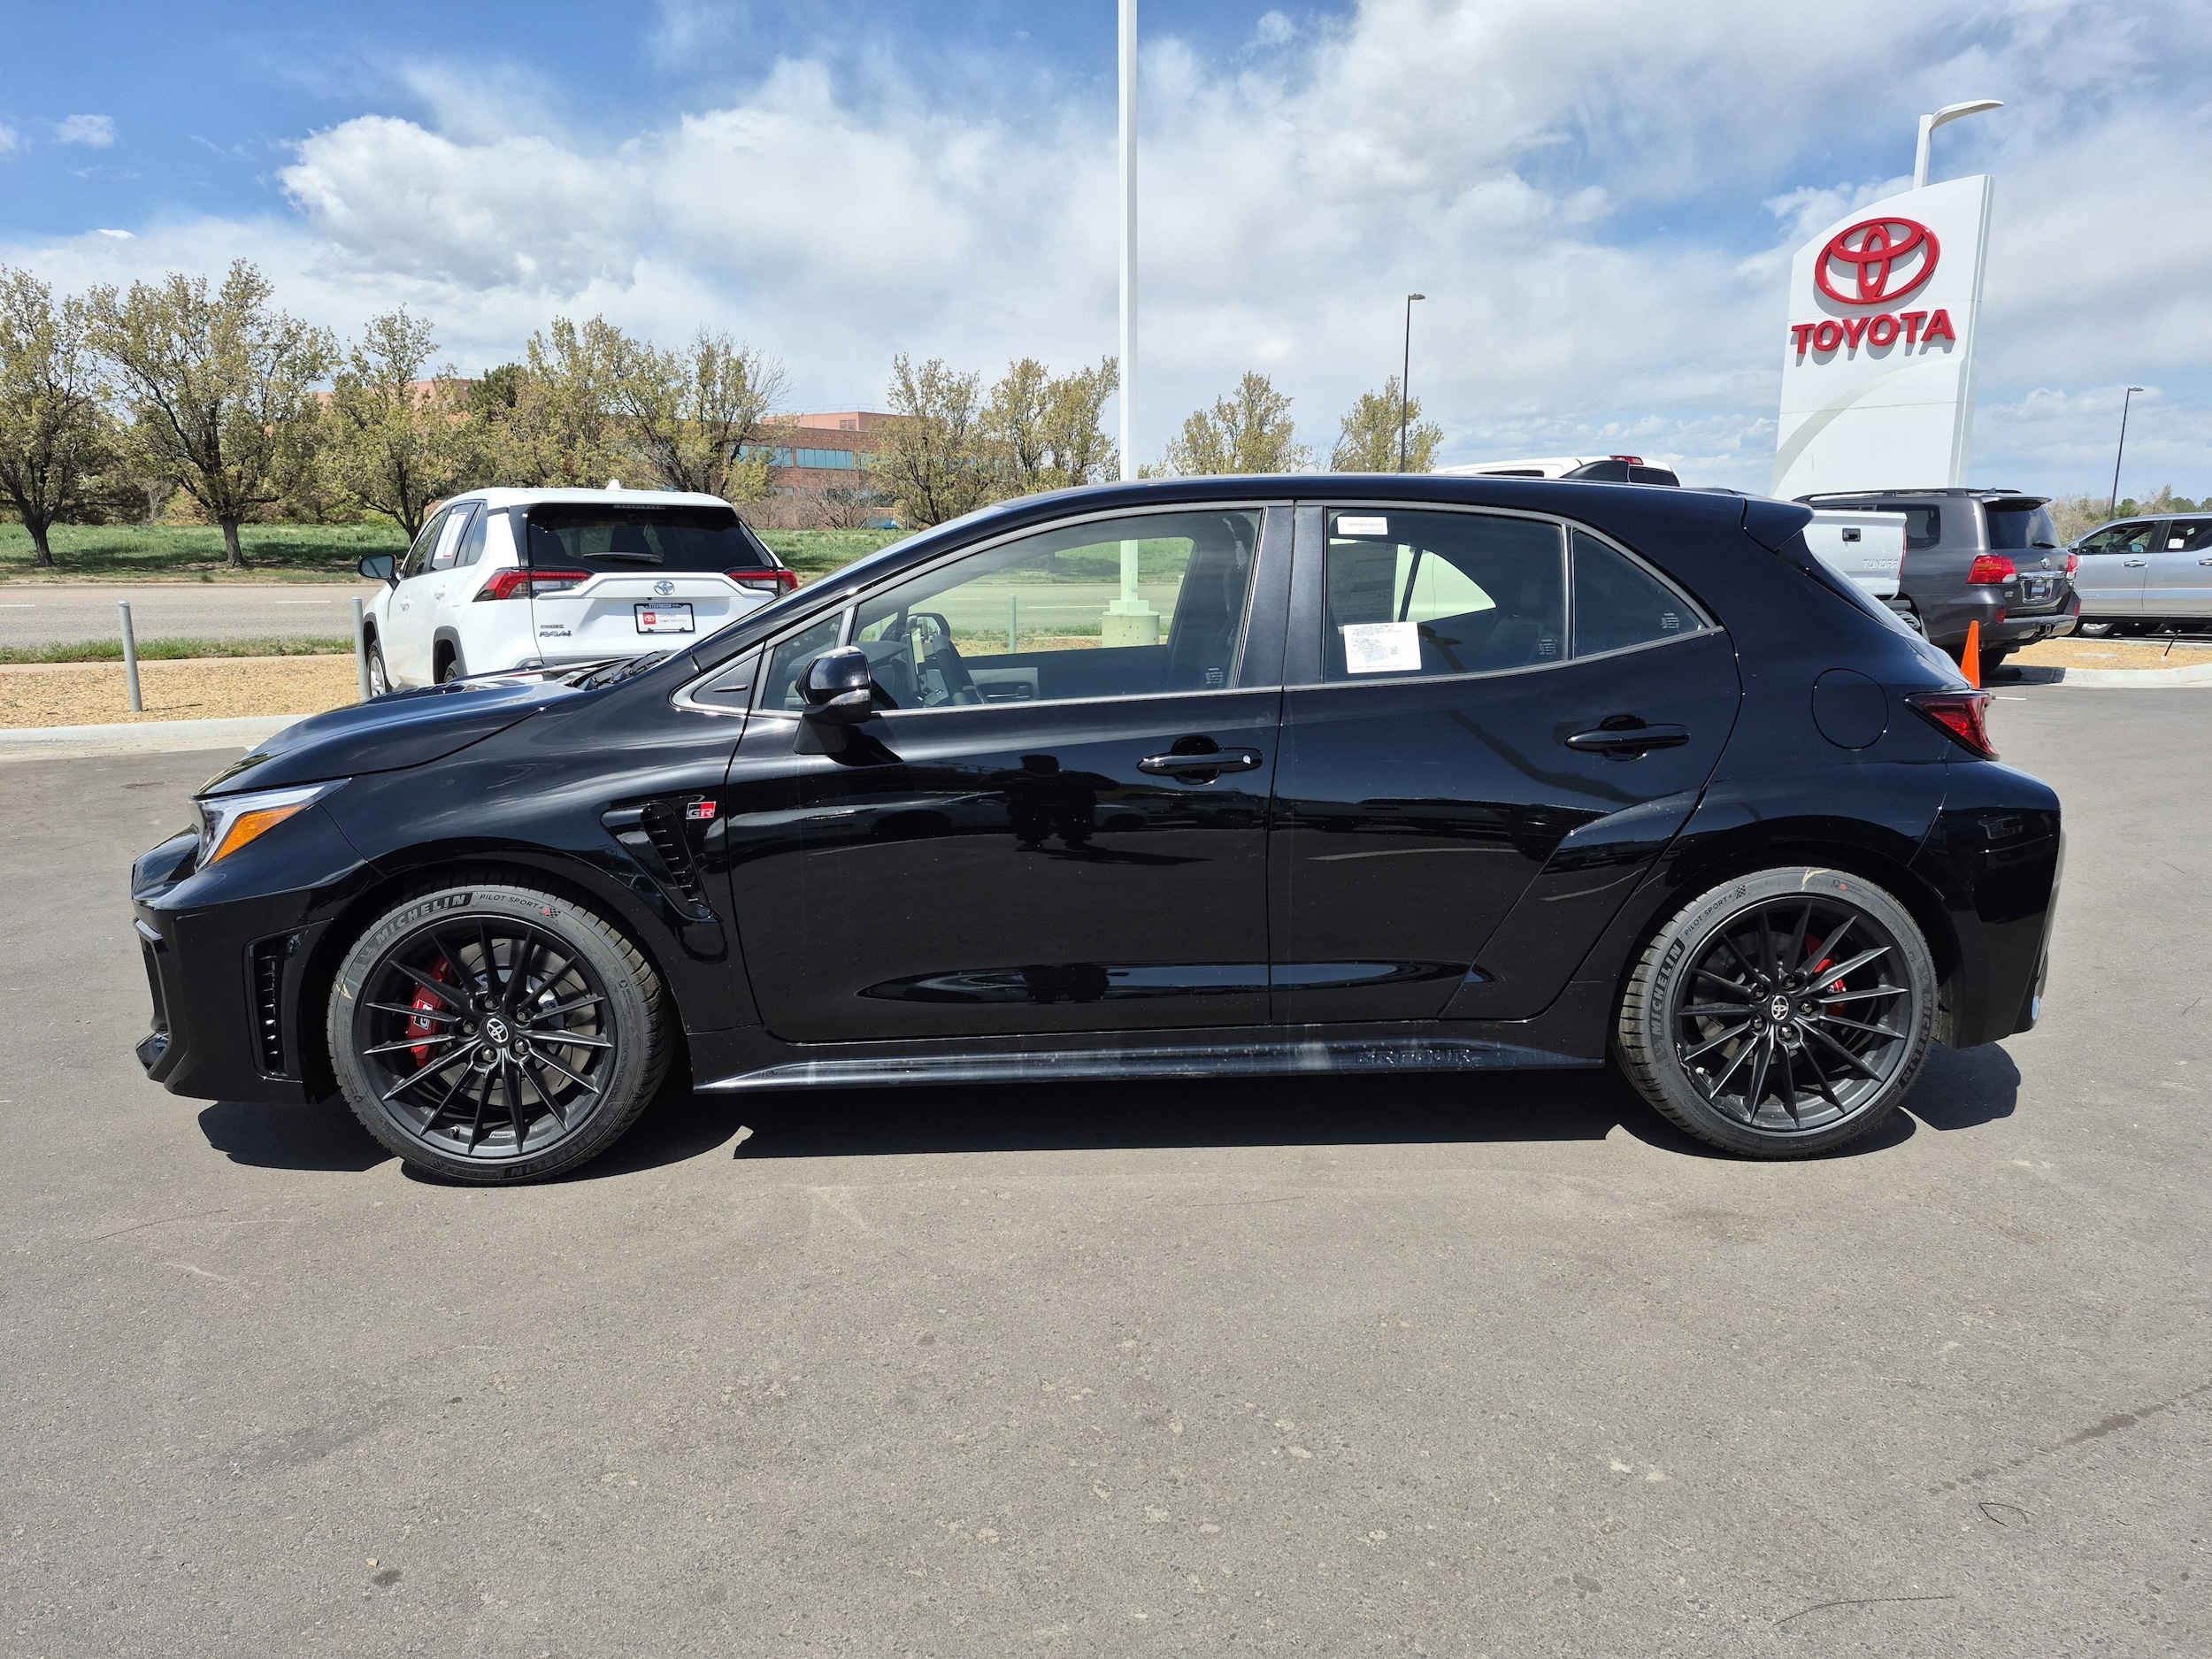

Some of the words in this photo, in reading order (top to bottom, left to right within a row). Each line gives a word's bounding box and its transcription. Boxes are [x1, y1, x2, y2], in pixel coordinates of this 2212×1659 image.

[1791, 309, 1956, 354] TOYOTA
[1863, 559, 1899, 569] TUNDRA
[375, 895, 465, 945] MICHELIN
[509, 896, 539, 909] SPORT
[1651, 943, 1682, 1036] MICHELIN
[1684, 915, 1703, 936] PILOT
[1704, 895, 1727, 917] SPORT
[1901, 992, 1932, 1083] MICHELIN
